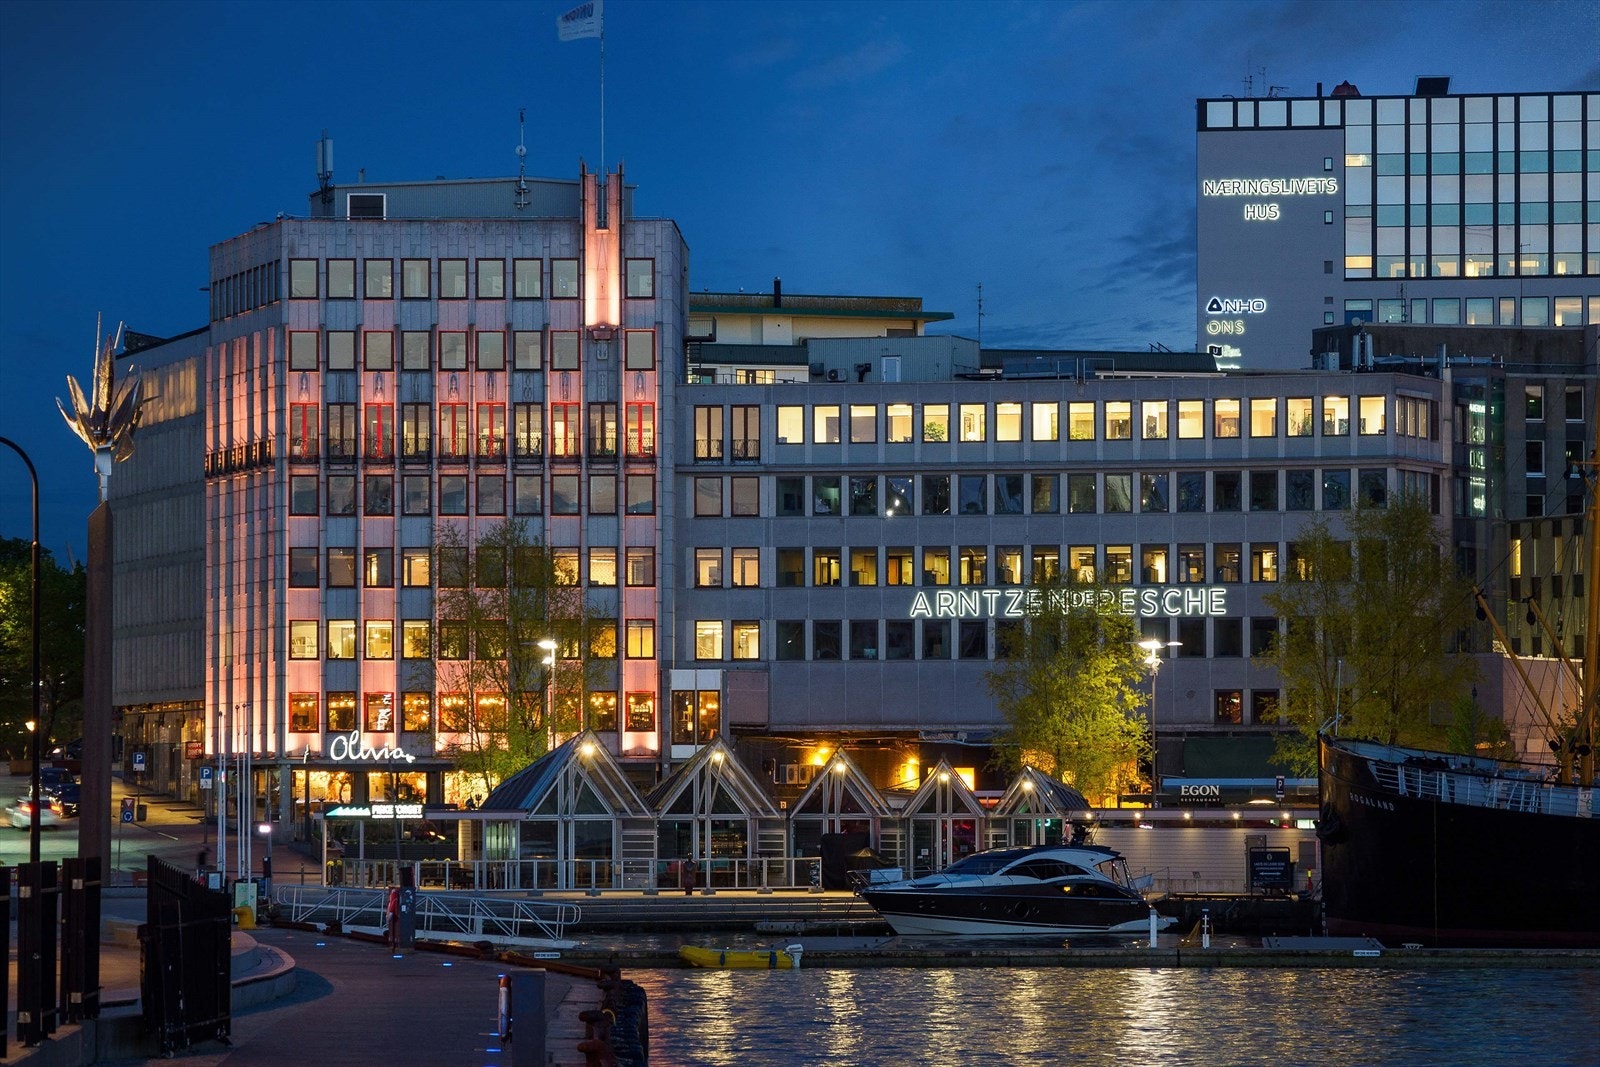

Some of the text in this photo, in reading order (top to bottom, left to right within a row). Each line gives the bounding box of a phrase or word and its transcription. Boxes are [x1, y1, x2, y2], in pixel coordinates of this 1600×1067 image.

[1203, 178, 1337, 196] NÆRINGSLIVETS
[1244, 204, 1280, 221] HUS
[1225, 298, 1266, 314] NHO
[1206, 320, 1245, 335] ONS
[910, 588, 1069, 618] ARNTZEN
[330, 729, 410, 763] Olivia
[1180, 785, 1220, 796] EGON
[1349, 791, 1395, 812] ROGALAND
